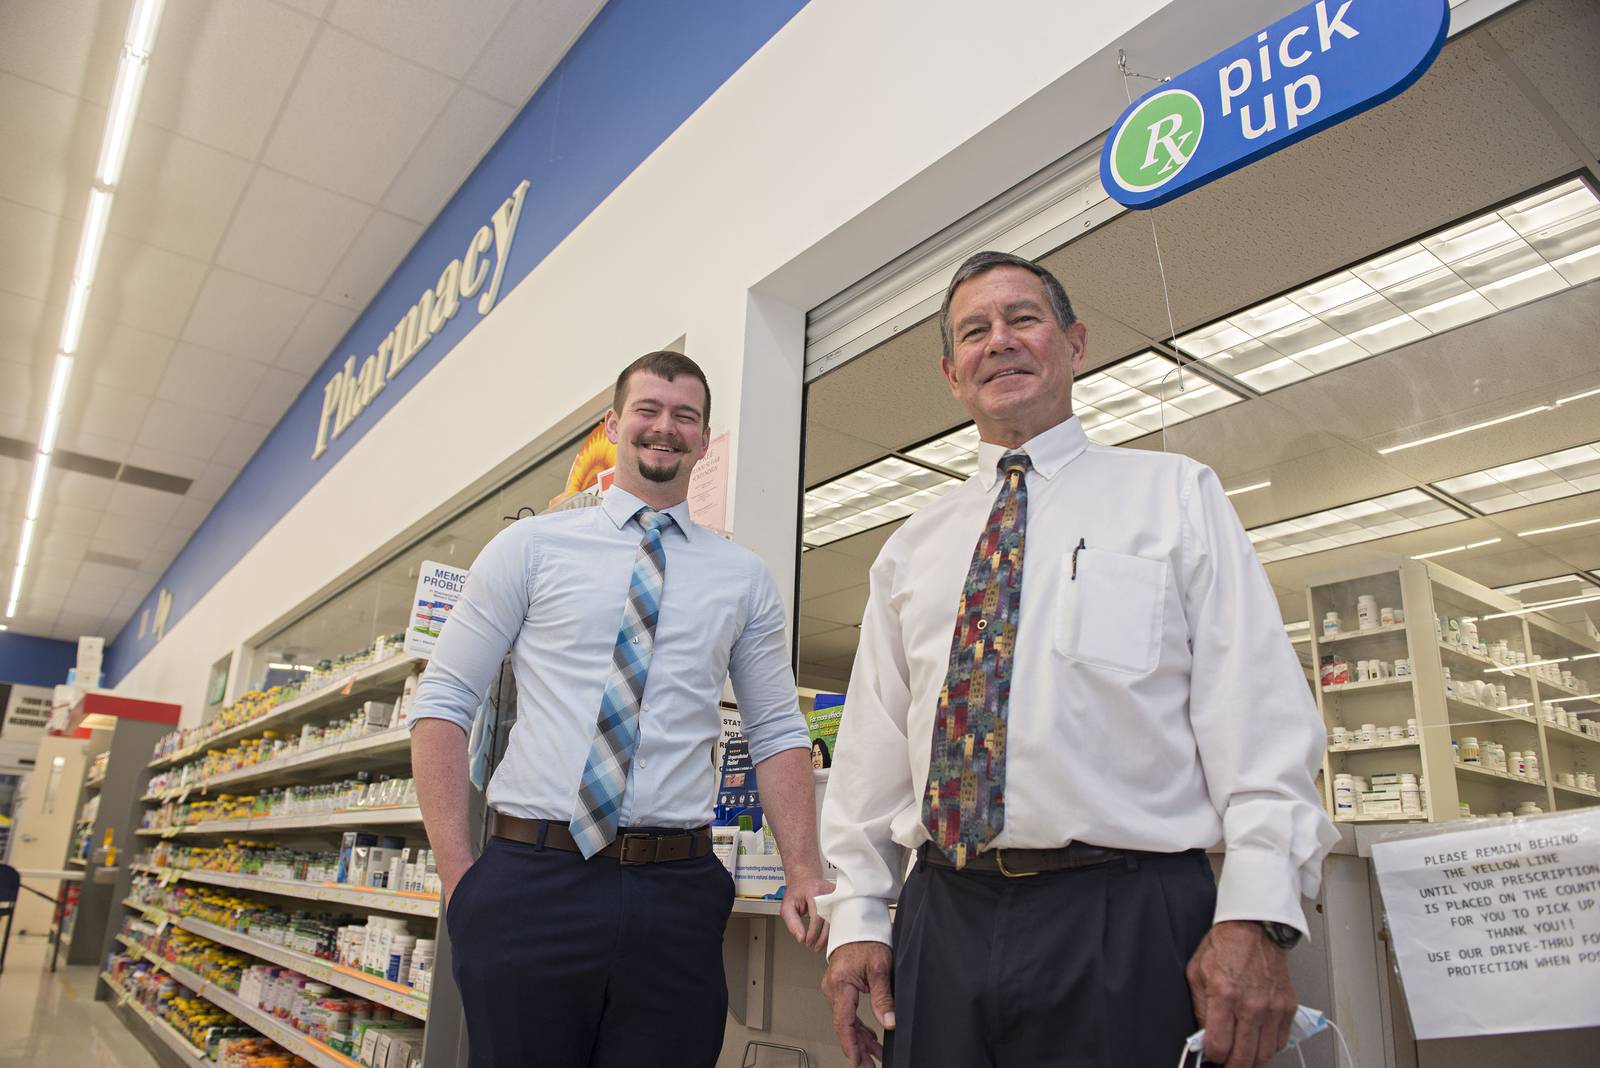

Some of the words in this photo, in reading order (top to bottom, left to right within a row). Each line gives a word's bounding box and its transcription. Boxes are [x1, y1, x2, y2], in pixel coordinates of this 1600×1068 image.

[1218, 0, 1360, 117] pick
[1240, 74, 1322, 140] up
[311, 179, 531, 461] Pharmacy
[1425, 851, 1468, 866] PLEASE
[1476, 843, 1522, 858] REMAIN
[1529, 834, 1578, 849] BEHIND
[1443, 868, 1466, 879] THE
[1472, 860, 1520, 875] YELLOW
[1527, 853, 1559, 867] LINE
[1419, 885, 1457, 899] UNTIL
[1463, 880, 1495, 893] YOUR
[1502, 864, 1600, 887] PRESCRIPTION
[1424, 904, 1439, 914] IS
[1446, 897, 1492, 912] PLACED
[1499, 893, 1516, 904] ON
[1524, 888, 1548, 901] THE
[1451, 913, 1474, 927] FOR
[1480, 911, 1506, 923] YOU
[1513, 907, 1529, 919] TO
[1537, 903, 1571, 916] PICK
[1486, 926, 1527, 940] THANK
[1533, 919, 1575, 934] YOU!!
[1427, 952, 1452, 963] USE
[1459, 948, 1484, 960] OUR
[1491, 937, 1574, 957] DRIVE-THRU
[1447, 958, 1529, 977] PROTECTION
[1535, 953, 1571, 968] WHEN
